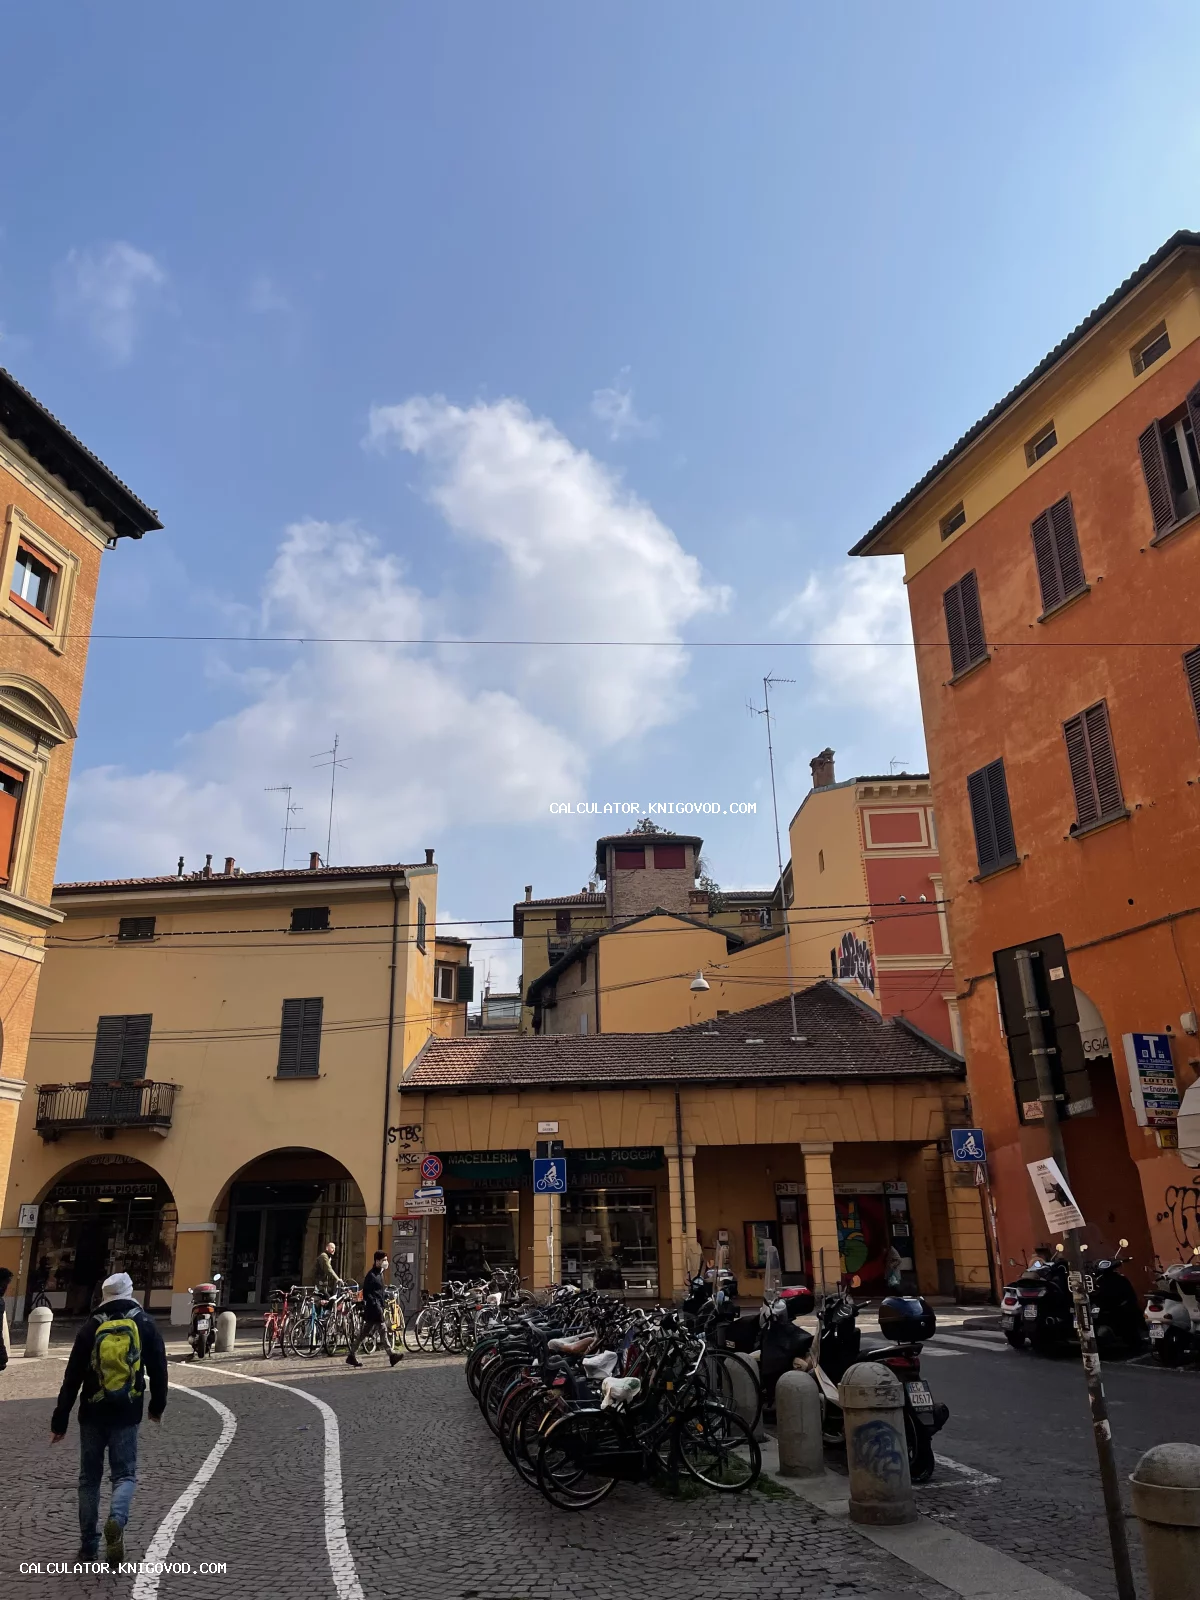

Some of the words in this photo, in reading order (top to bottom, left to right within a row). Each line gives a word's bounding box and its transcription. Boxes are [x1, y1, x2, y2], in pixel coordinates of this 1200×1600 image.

[1083, 1037, 1109, 1053] GGIA
[1143, 1036, 1159, 1058] T
[448, 1153, 518, 1164] MACELLERIA
[579, 1151, 606, 1161] ELLA
[611, 1150, 657, 1161] PIOGGIA
[473, 1174, 532, 1187] MACELLERI
[582, 1172, 625, 1184] PIOGGIA
[115, 1184, 156, 1194] PIOGGIA
